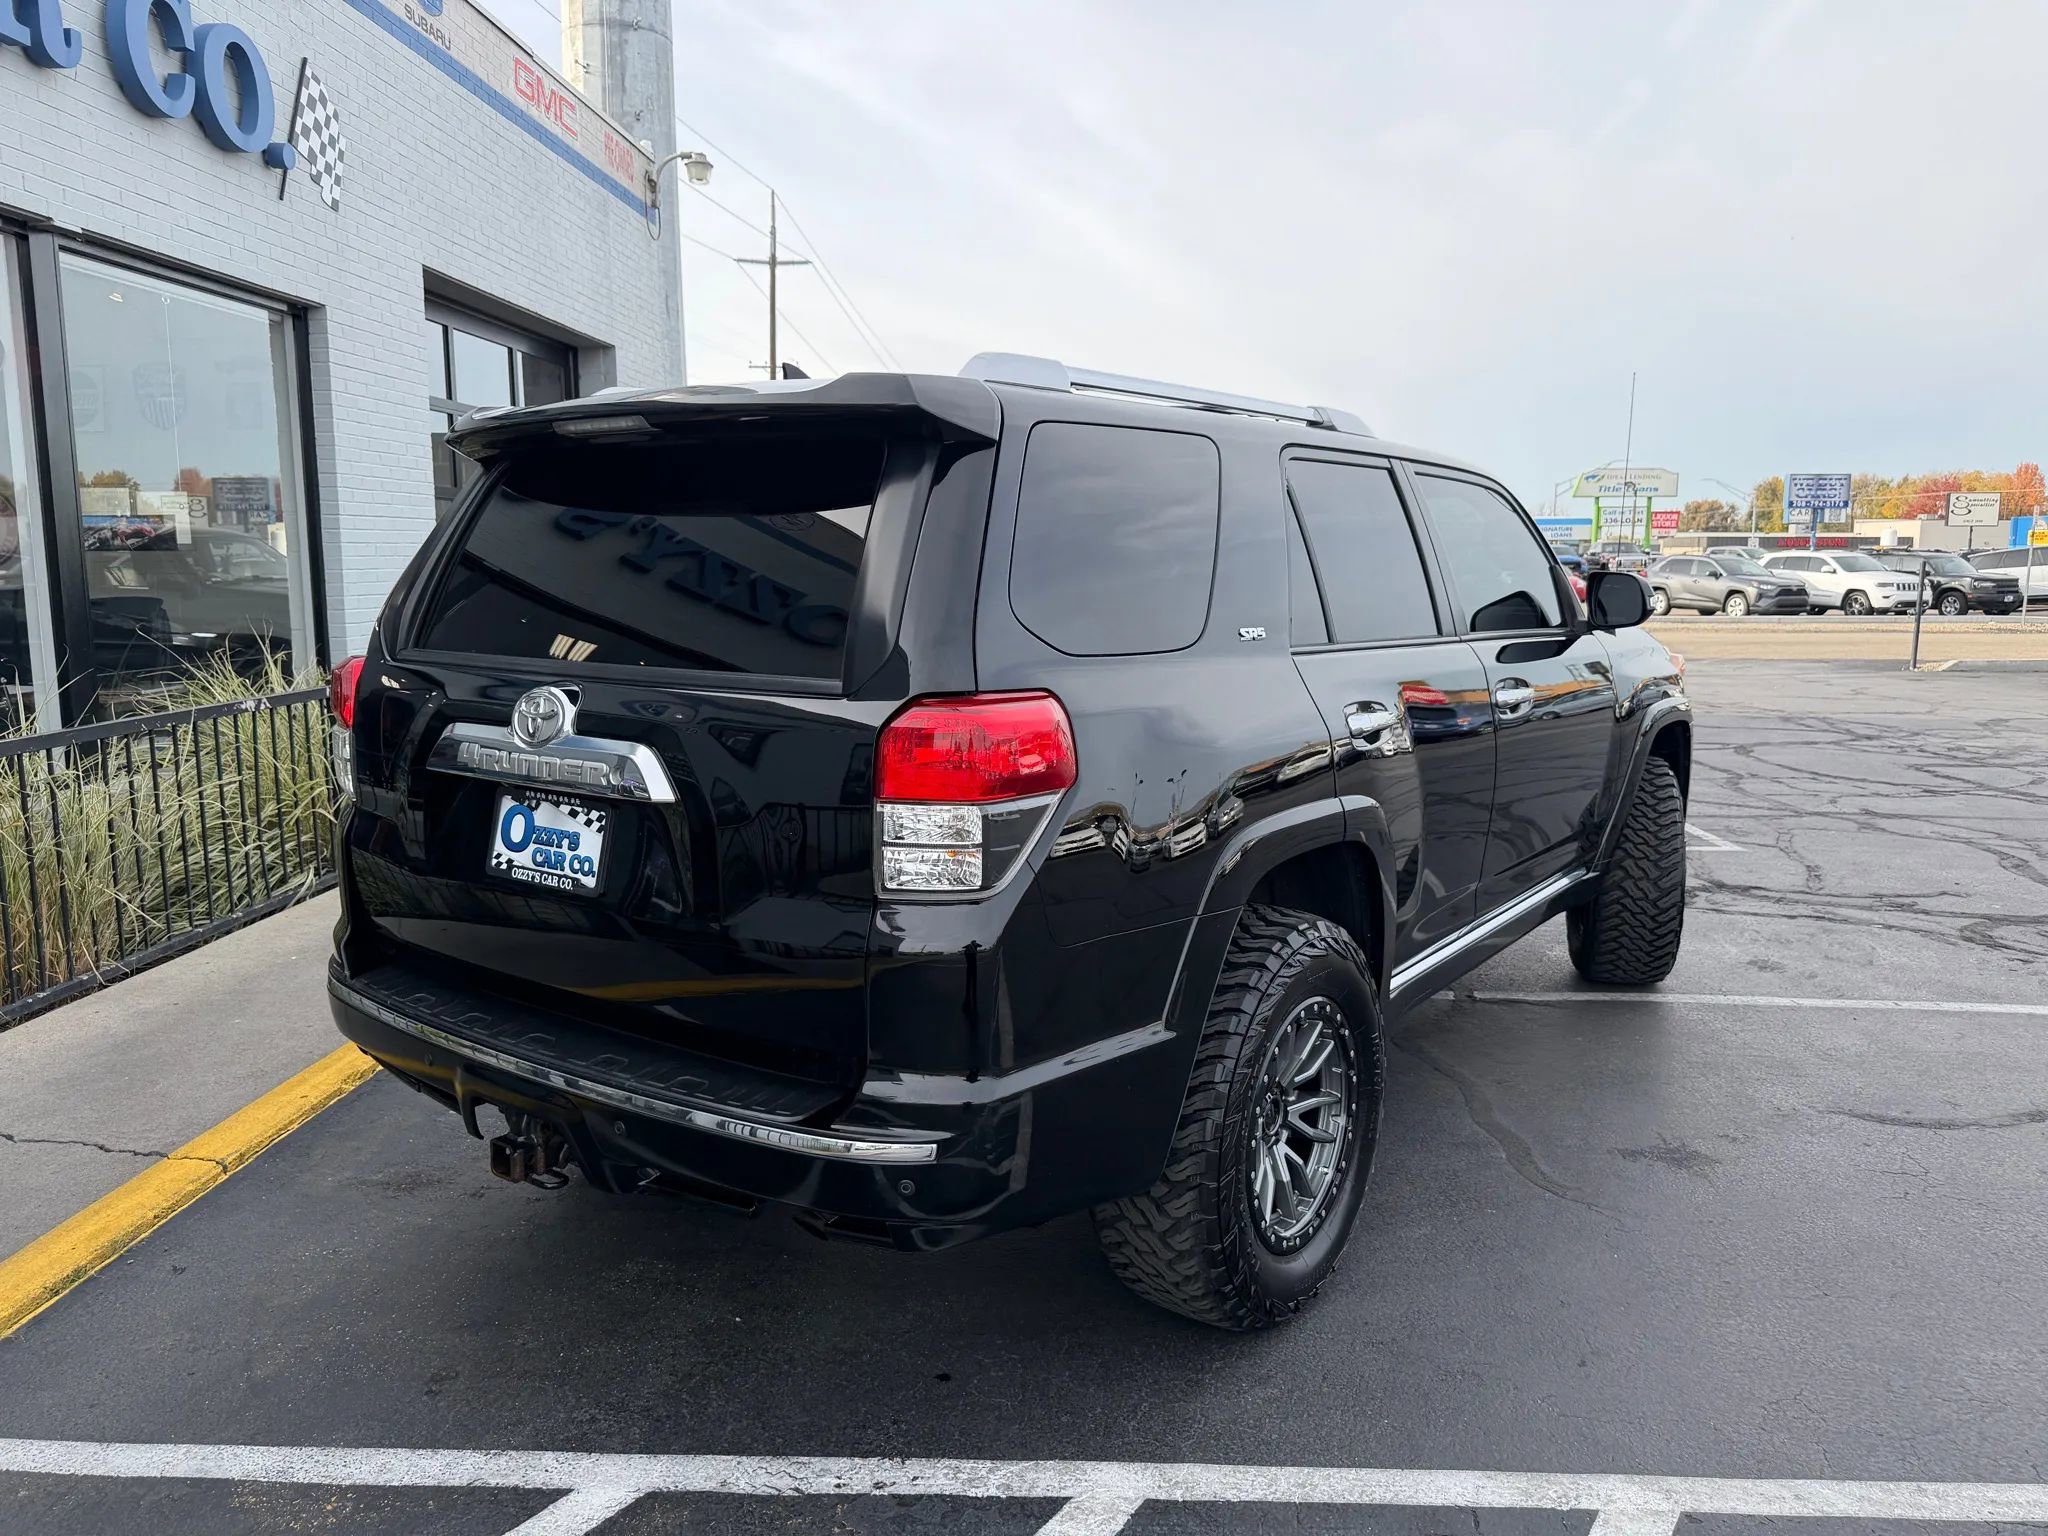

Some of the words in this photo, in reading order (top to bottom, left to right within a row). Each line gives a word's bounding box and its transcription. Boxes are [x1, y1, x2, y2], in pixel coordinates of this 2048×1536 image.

[404, 3, 451, 50] SUBARU
[513, 56, 578, 140] GMC
[1652, 512, 1678, 521] LIQUOR
[1652, 520, 1677, 528] STORE
[1790, 508, 1810, 517] CAR
[457, 742, 610, 786] 4RUNNER
[501, 804, 581, 852] OZZY'S
[532, 847, 566, 872] CAR
[569, 854, 596, 878] CO.
[511, 867, 540, 883] OZZY'S
[541, 873, 558, 887] CAR
[560, 878, 573, 890] CO.
